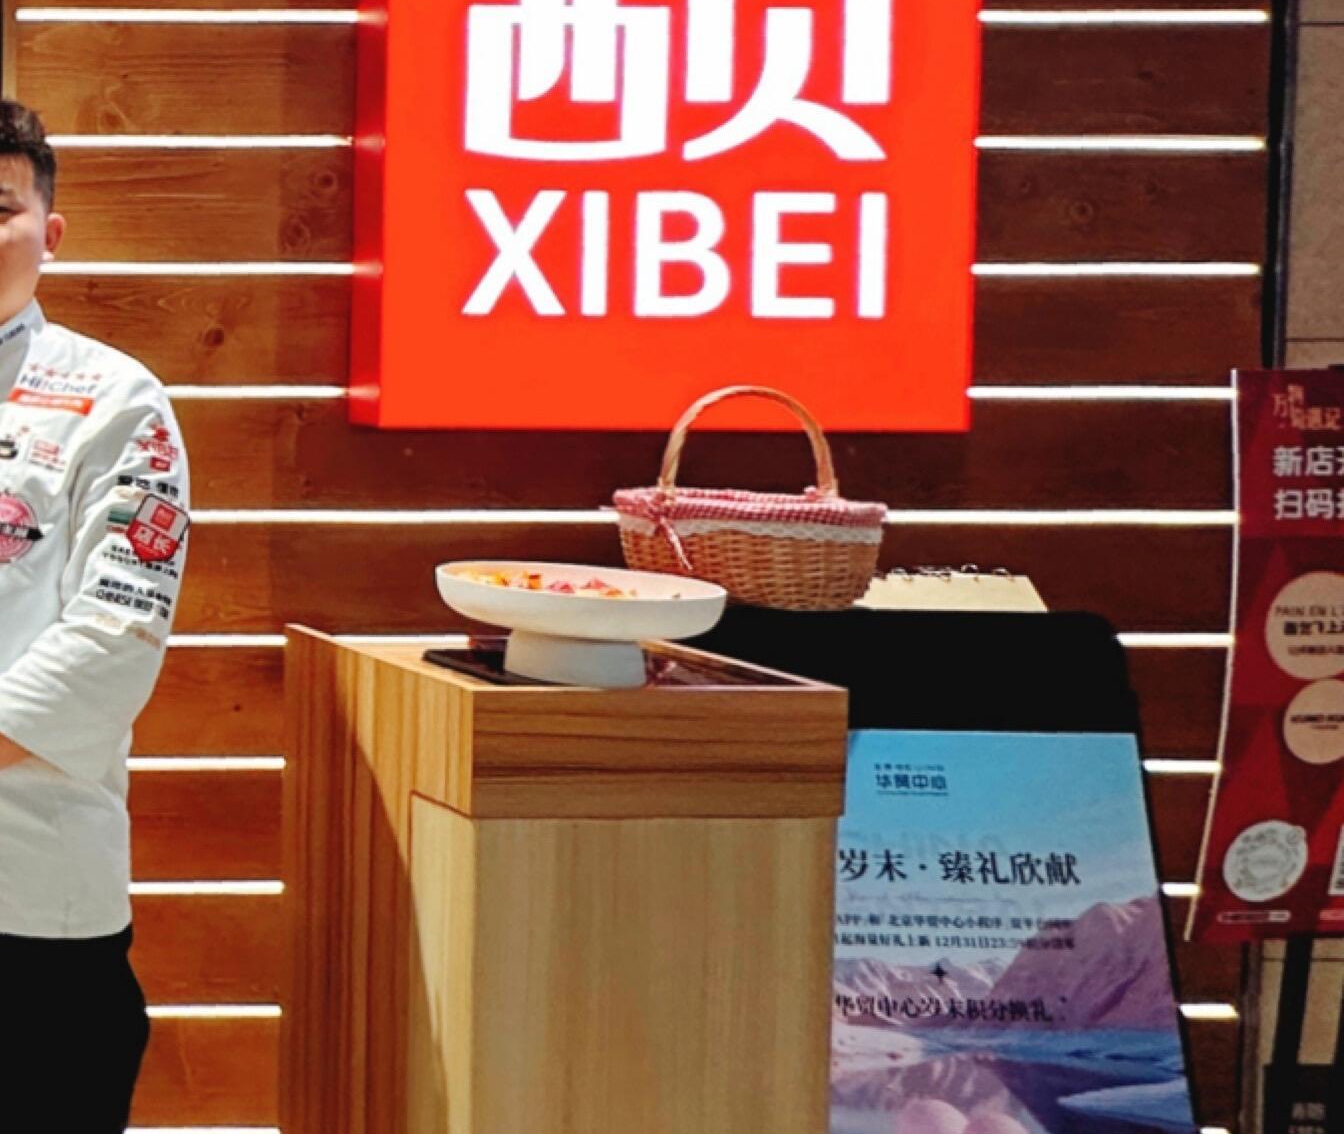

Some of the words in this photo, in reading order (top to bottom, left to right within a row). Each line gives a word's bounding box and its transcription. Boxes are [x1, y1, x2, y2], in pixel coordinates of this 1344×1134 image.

[461, 189, 888, 319] XIBEI
[1272, 446, 1344, 477] 新店
[1274, 489, 1344, 520] 扫码
